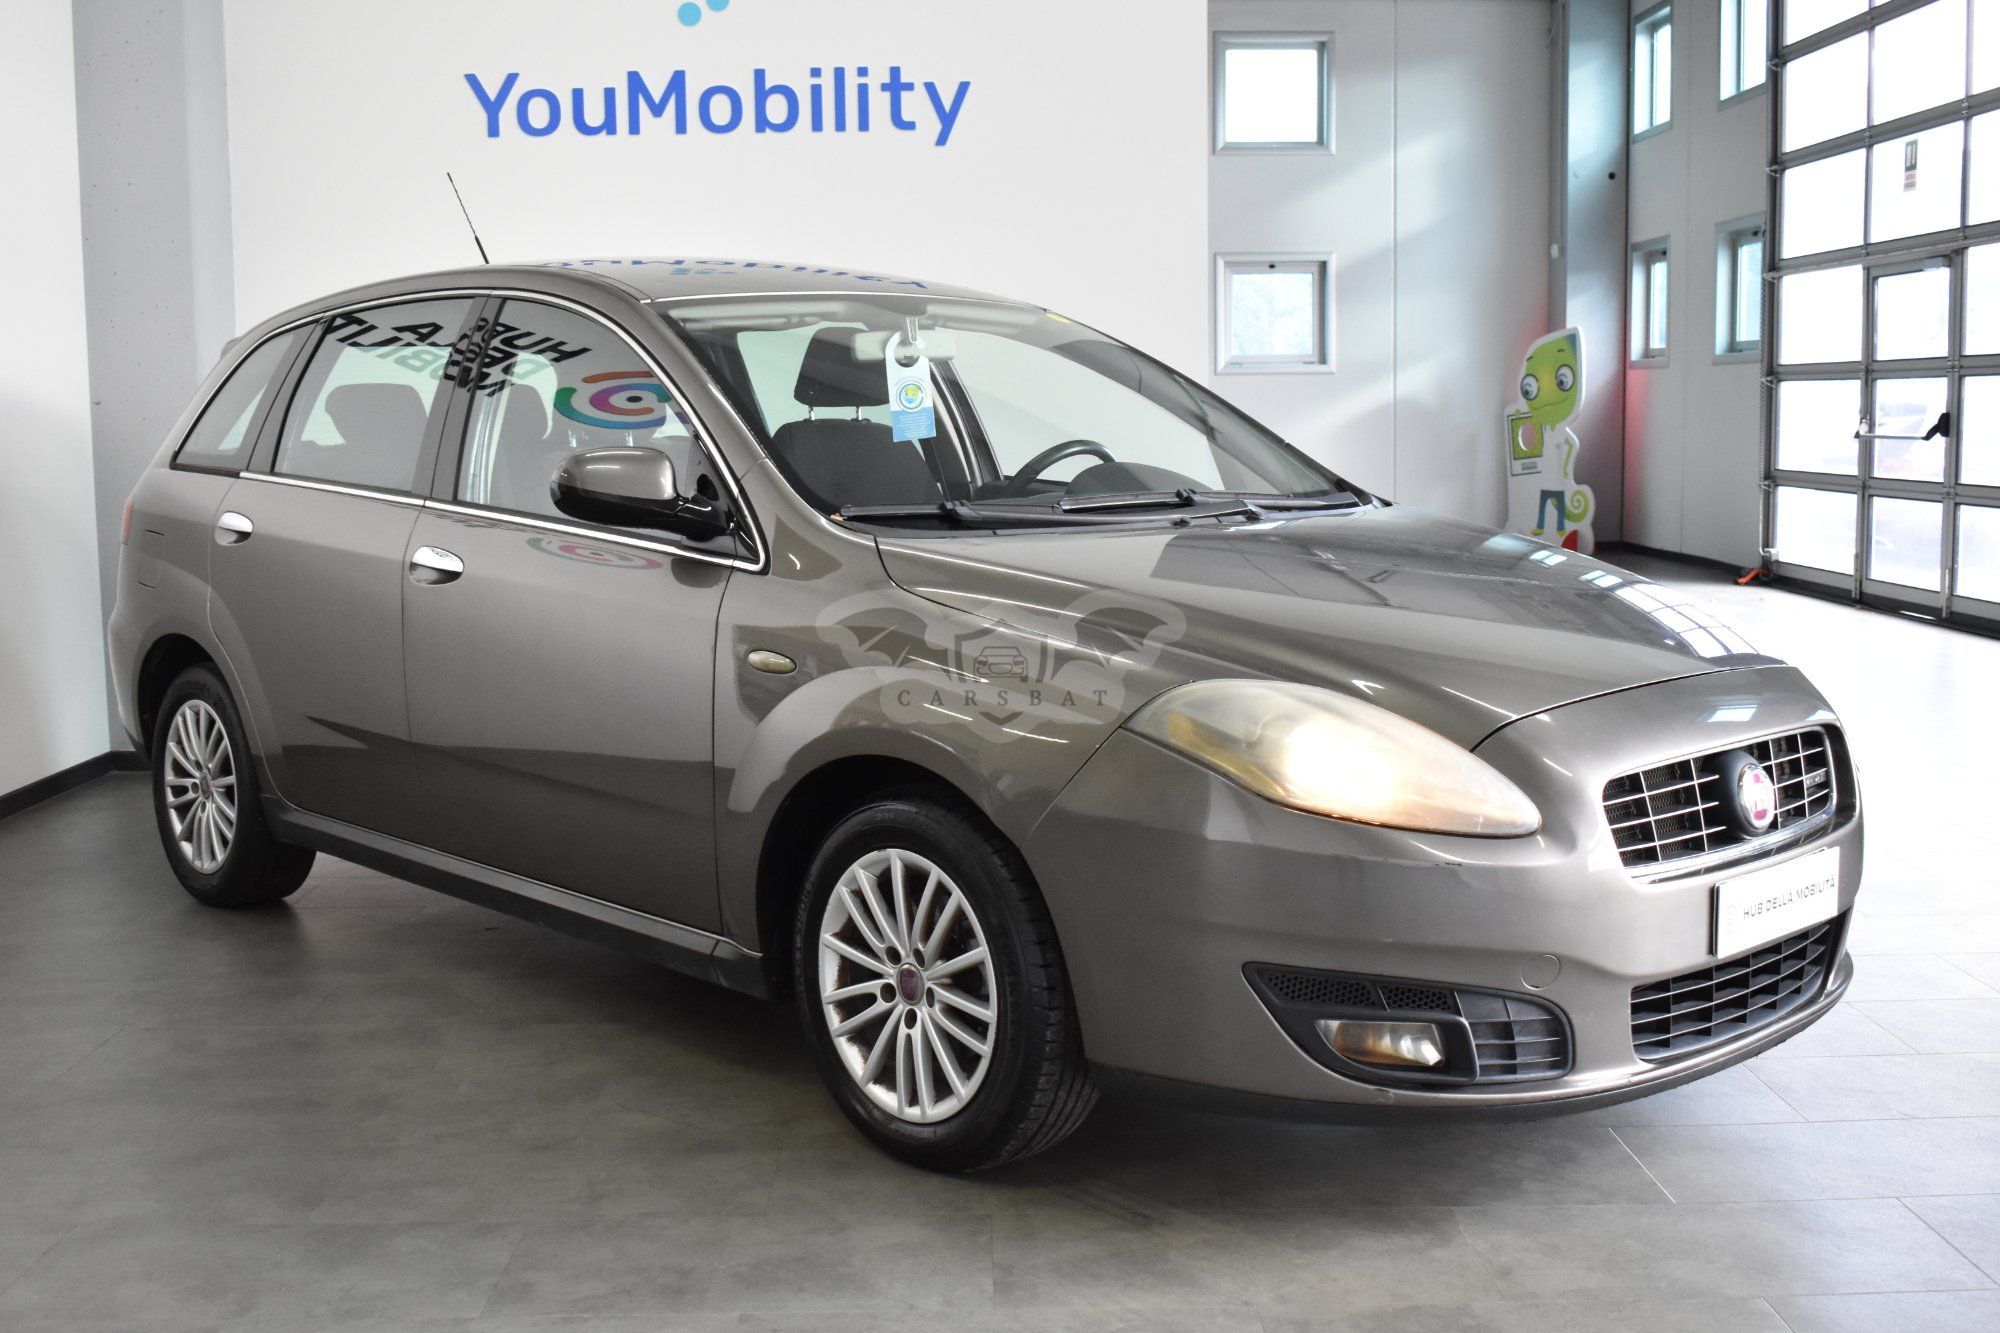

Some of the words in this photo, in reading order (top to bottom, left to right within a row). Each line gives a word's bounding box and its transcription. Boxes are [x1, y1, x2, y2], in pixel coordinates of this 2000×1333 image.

[464, 66, 971, 147] YouMobility
[1743, 902, 1763, 920] HUB
[1765, 892, 1793, 912] DELLA
